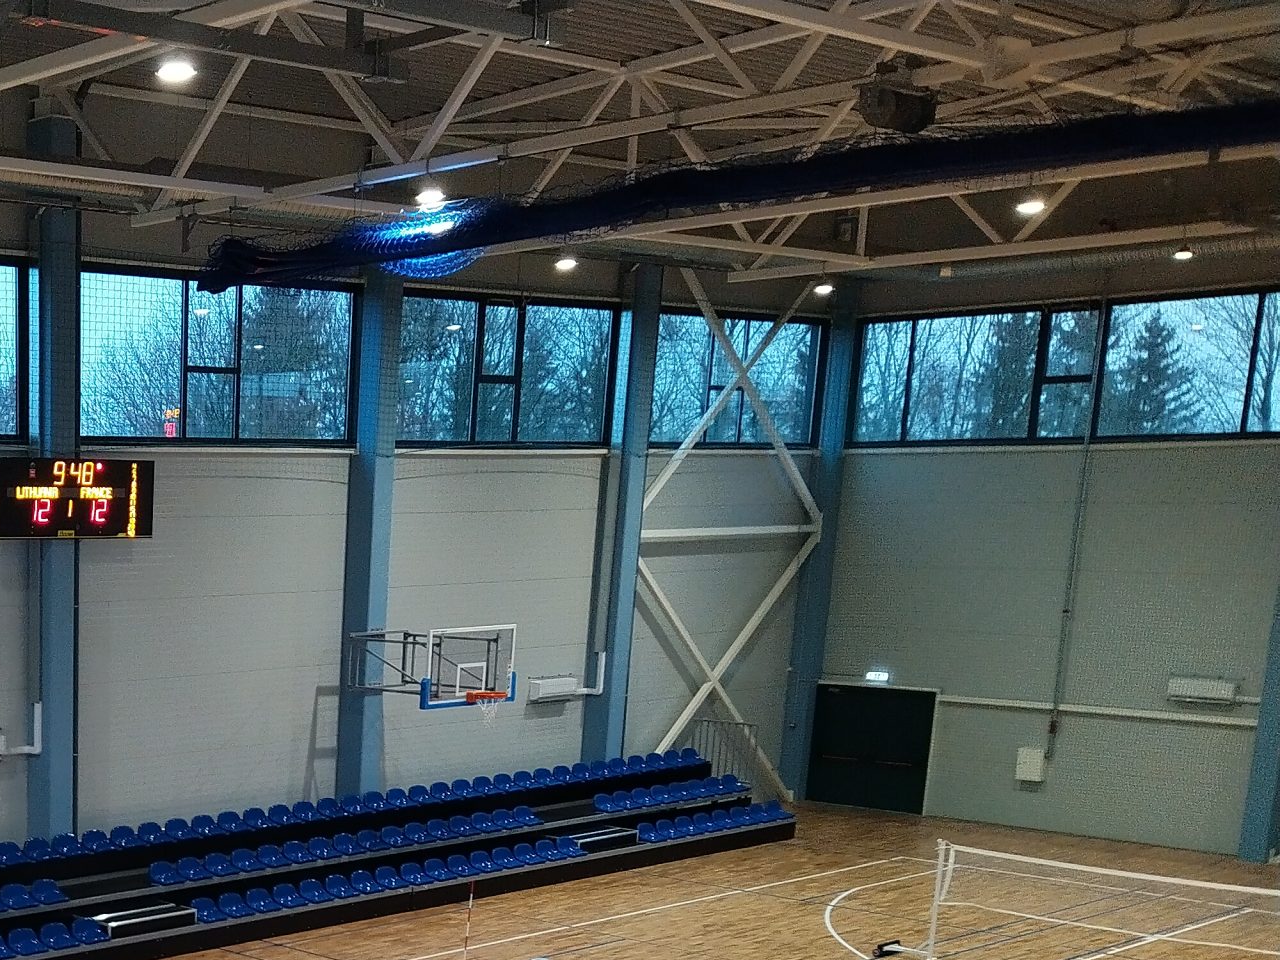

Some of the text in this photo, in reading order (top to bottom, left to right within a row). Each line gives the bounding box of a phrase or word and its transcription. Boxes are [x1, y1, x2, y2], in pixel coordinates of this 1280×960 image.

[53, 461, 95, 486] 9:48
[16, 486, 113, 499] LITHUANIA FRANCE
[34, 499, 107, 522] 12 1 12
